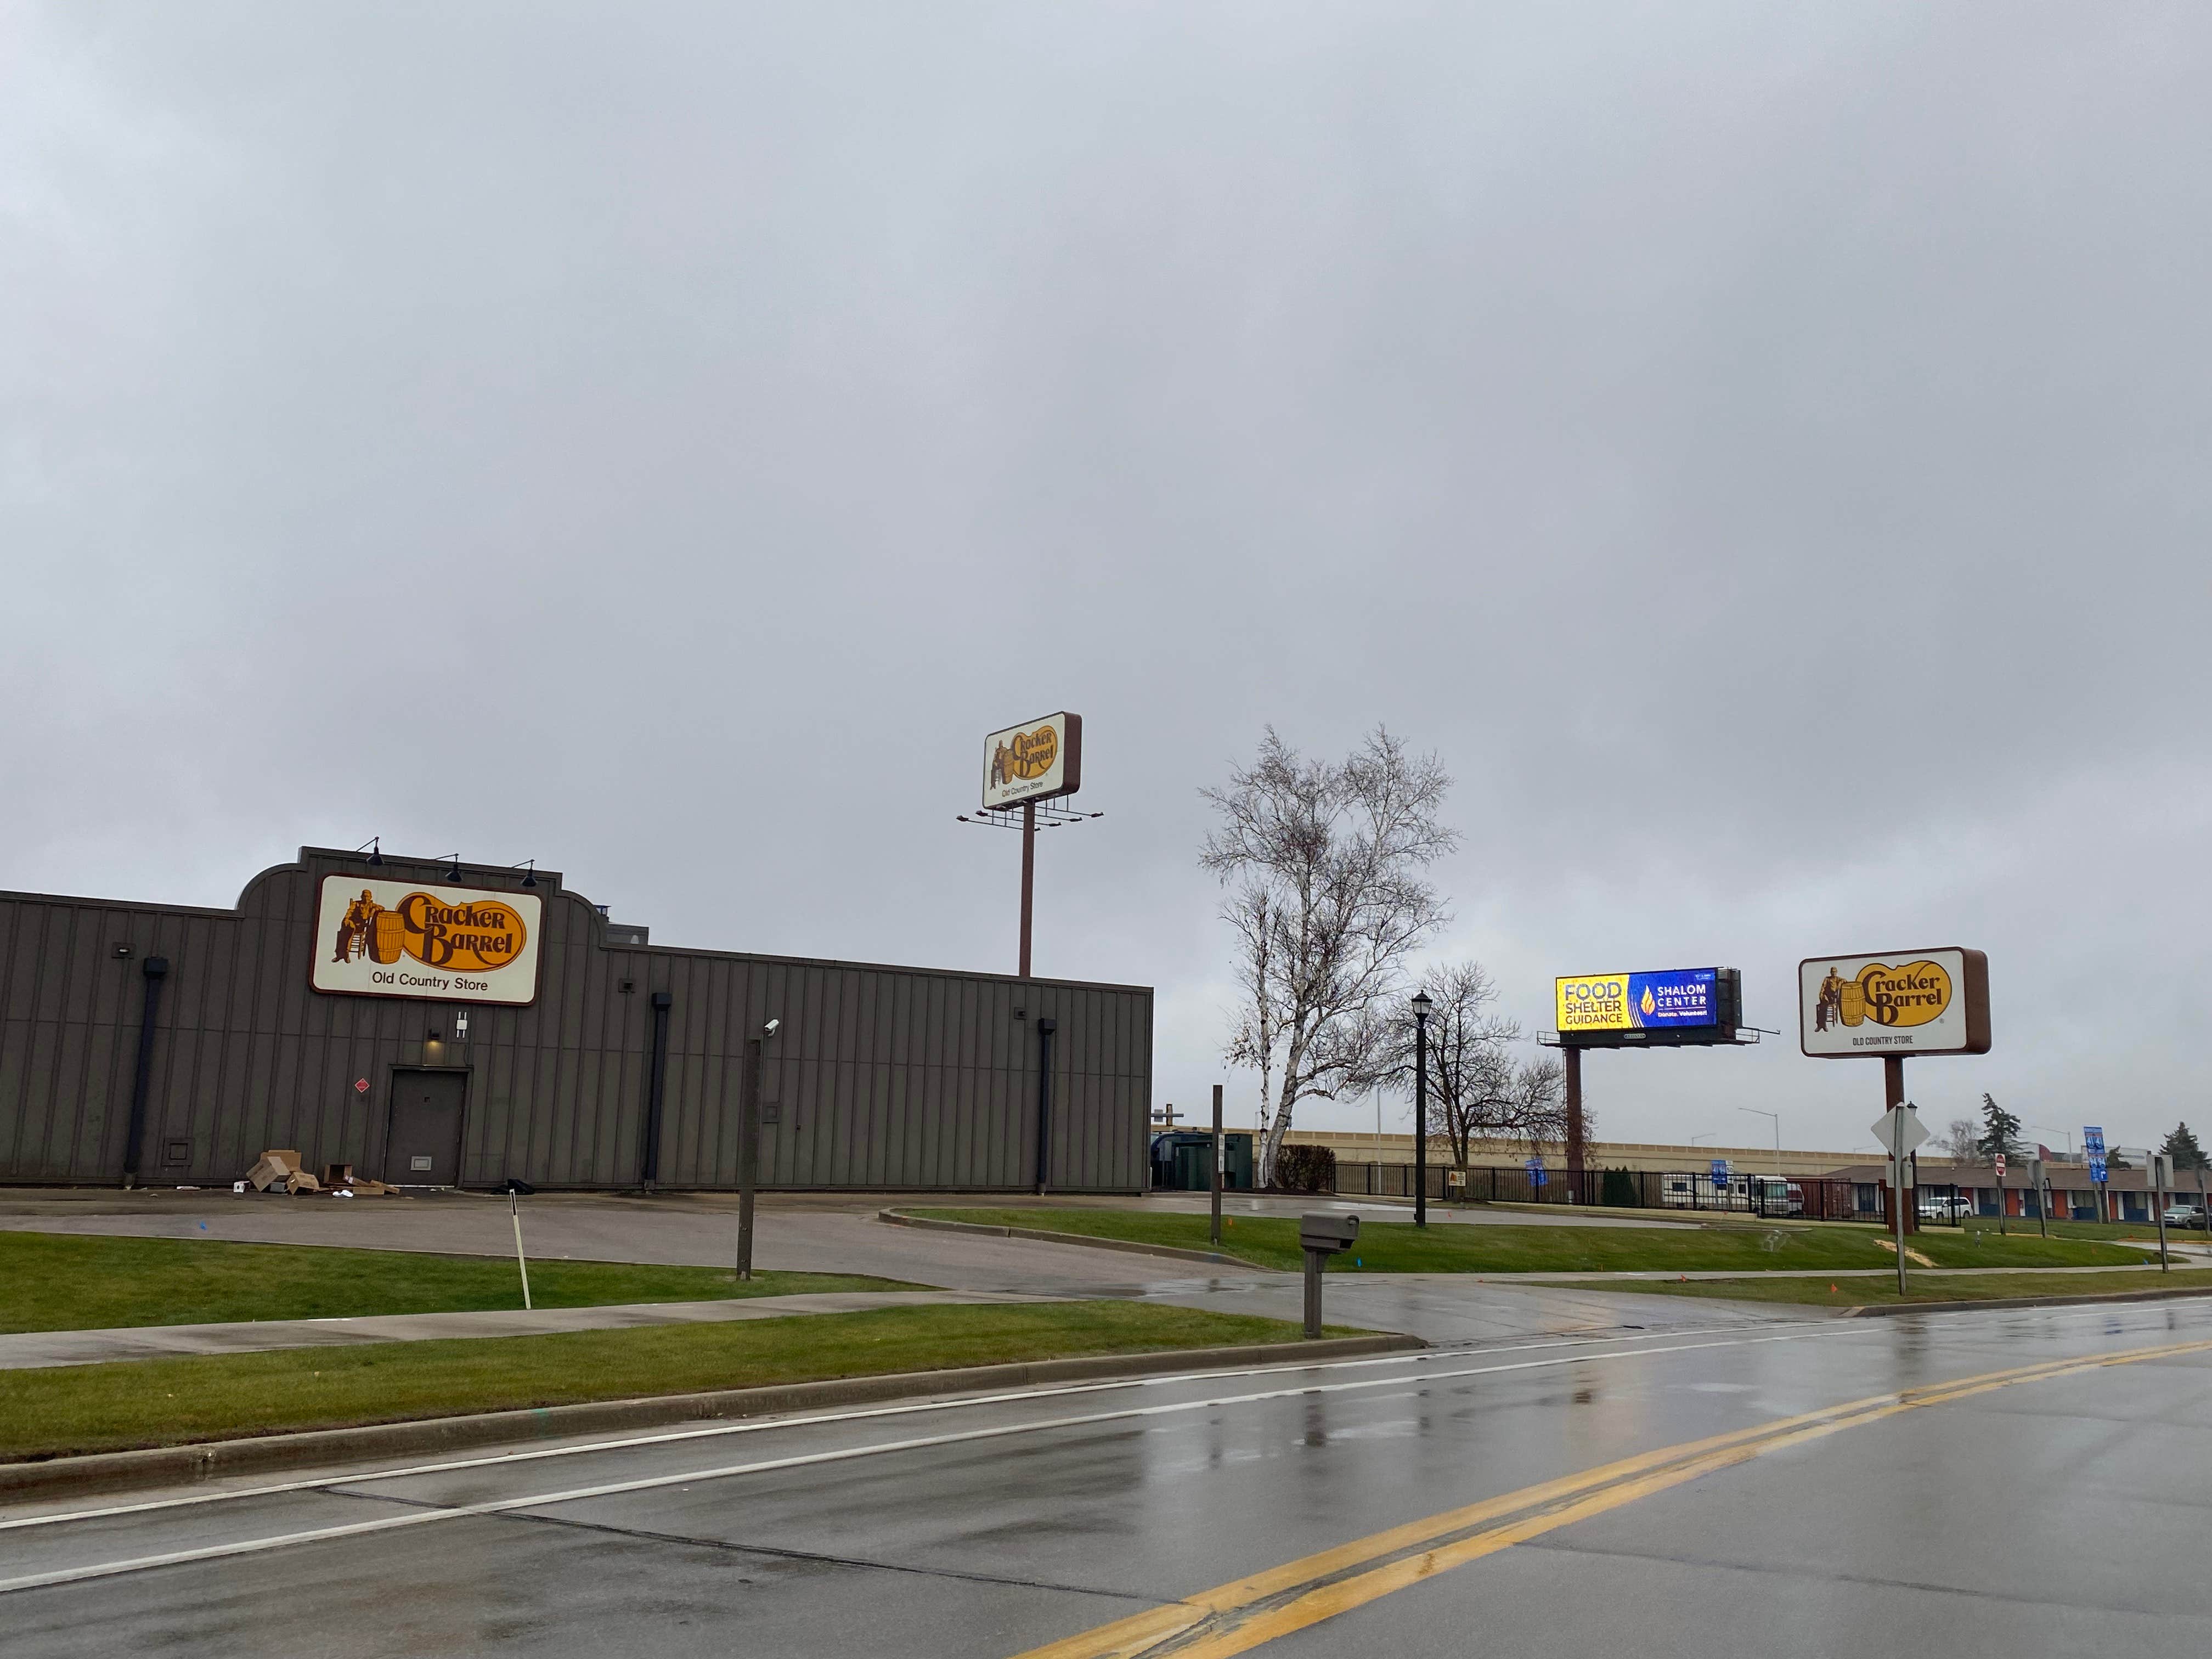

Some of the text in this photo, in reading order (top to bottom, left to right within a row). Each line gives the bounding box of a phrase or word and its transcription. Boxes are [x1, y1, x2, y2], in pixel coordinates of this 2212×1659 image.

[1012, 732, 1052, 760] Cracker
[1020, 744, 1053, 777] Barrel
[1002, 781, 1043, 797] Old Country Store
[397, 895, 505, 934] Cracker
[421, 924, 512, 966] Barrel
[372, 971, 488, 991] Old Country Store
[1863, 970, 1940, 1007] Cracker
[1565, 982, 1622, 1001] FOOD
[1657, 984, 1706, 996] SHALOM
[1566, 1000, 1622, 1014] SHELTER
[1657, 996, 1706, 1007] CENTER
[1876, 990, 1942, 1024] Barrel
[1565, 1013, 1623, 1024] GUIDANCE
[1853, 1035, 1913, 1046] OLD COUNTRY STORE
[2087, 1136, 2093, 1145] 41
[2096, 1137, 2102, 1145] 41
